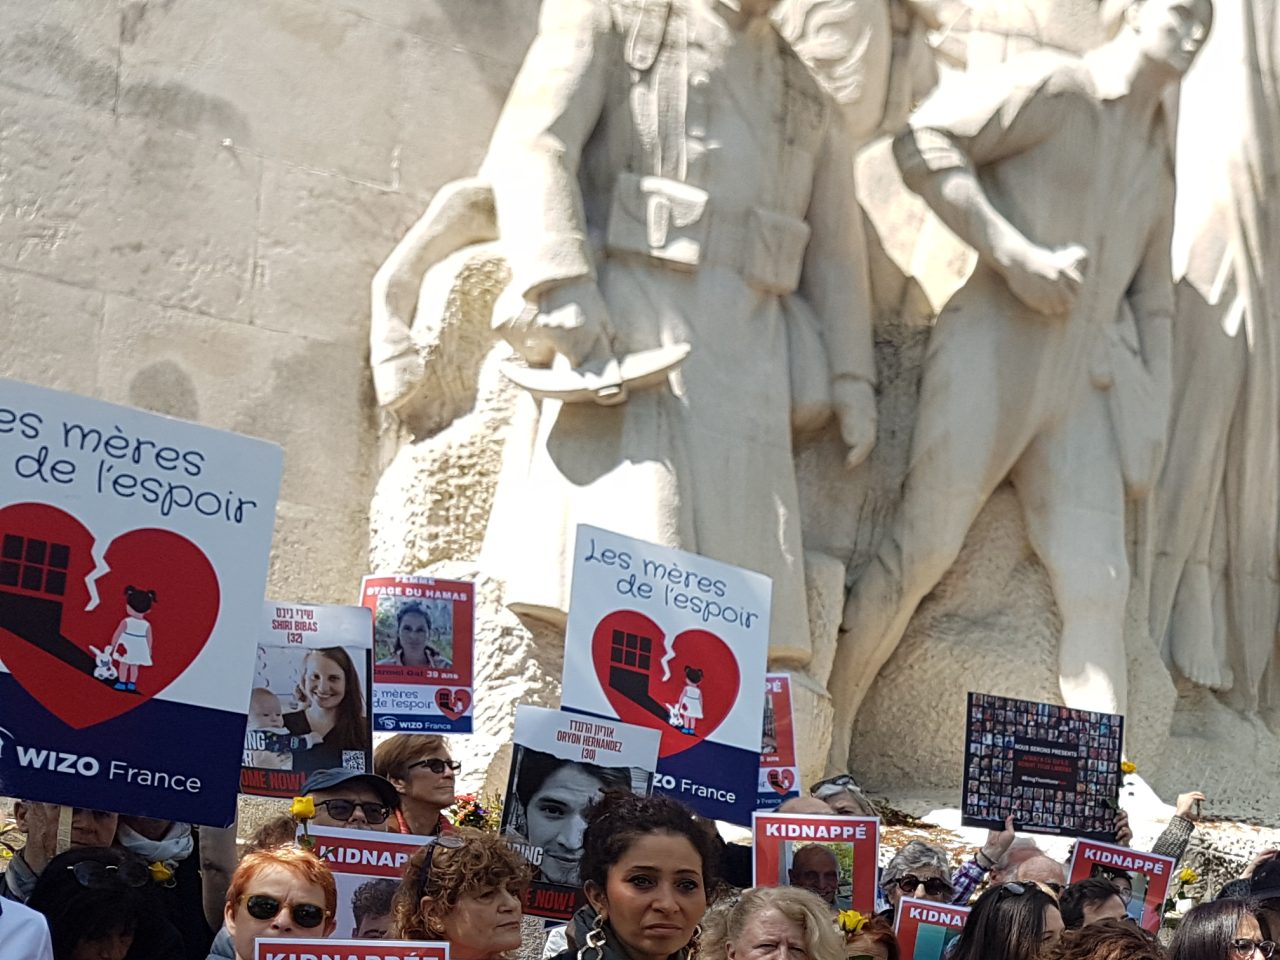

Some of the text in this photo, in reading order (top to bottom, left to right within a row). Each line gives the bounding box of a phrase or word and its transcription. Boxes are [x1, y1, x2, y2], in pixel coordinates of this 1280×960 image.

[0, 409, 206, 477] es mères
[15, 446, 257, 524] de l'espoir
[584, 539, 727, 597] Les mères
[366, 587, 467, 601] OTAGE DU HAMAS
[616, 574, 758, 629] de l'espoir
[271, 619, 318, 632] SHIRI BIBAS
[287, 631, 303, 645] (32)
[441, 672, 460, 680] ans
[381, 688, 419, 700] mères
[391, 699, 434, 711] l'espoir
[399, 721, 452, 730] WIZO France
[556, 729, 623, 753] ORYON HERNANDEZ
[581, 746, 597, 761] (30)
[16, 745, 202, 793] WIZO France
[680, 780, 736, 804] France
[766, 823, 867, 839] KIDNAPPÉ
[320, 845, 410, 868] KIDNAP
[1084, 848, 1164, 875] KIDNAPPÉ
[535, 888, 577, 912] NOW!
[909, 907, 967, 927] KIDNA
